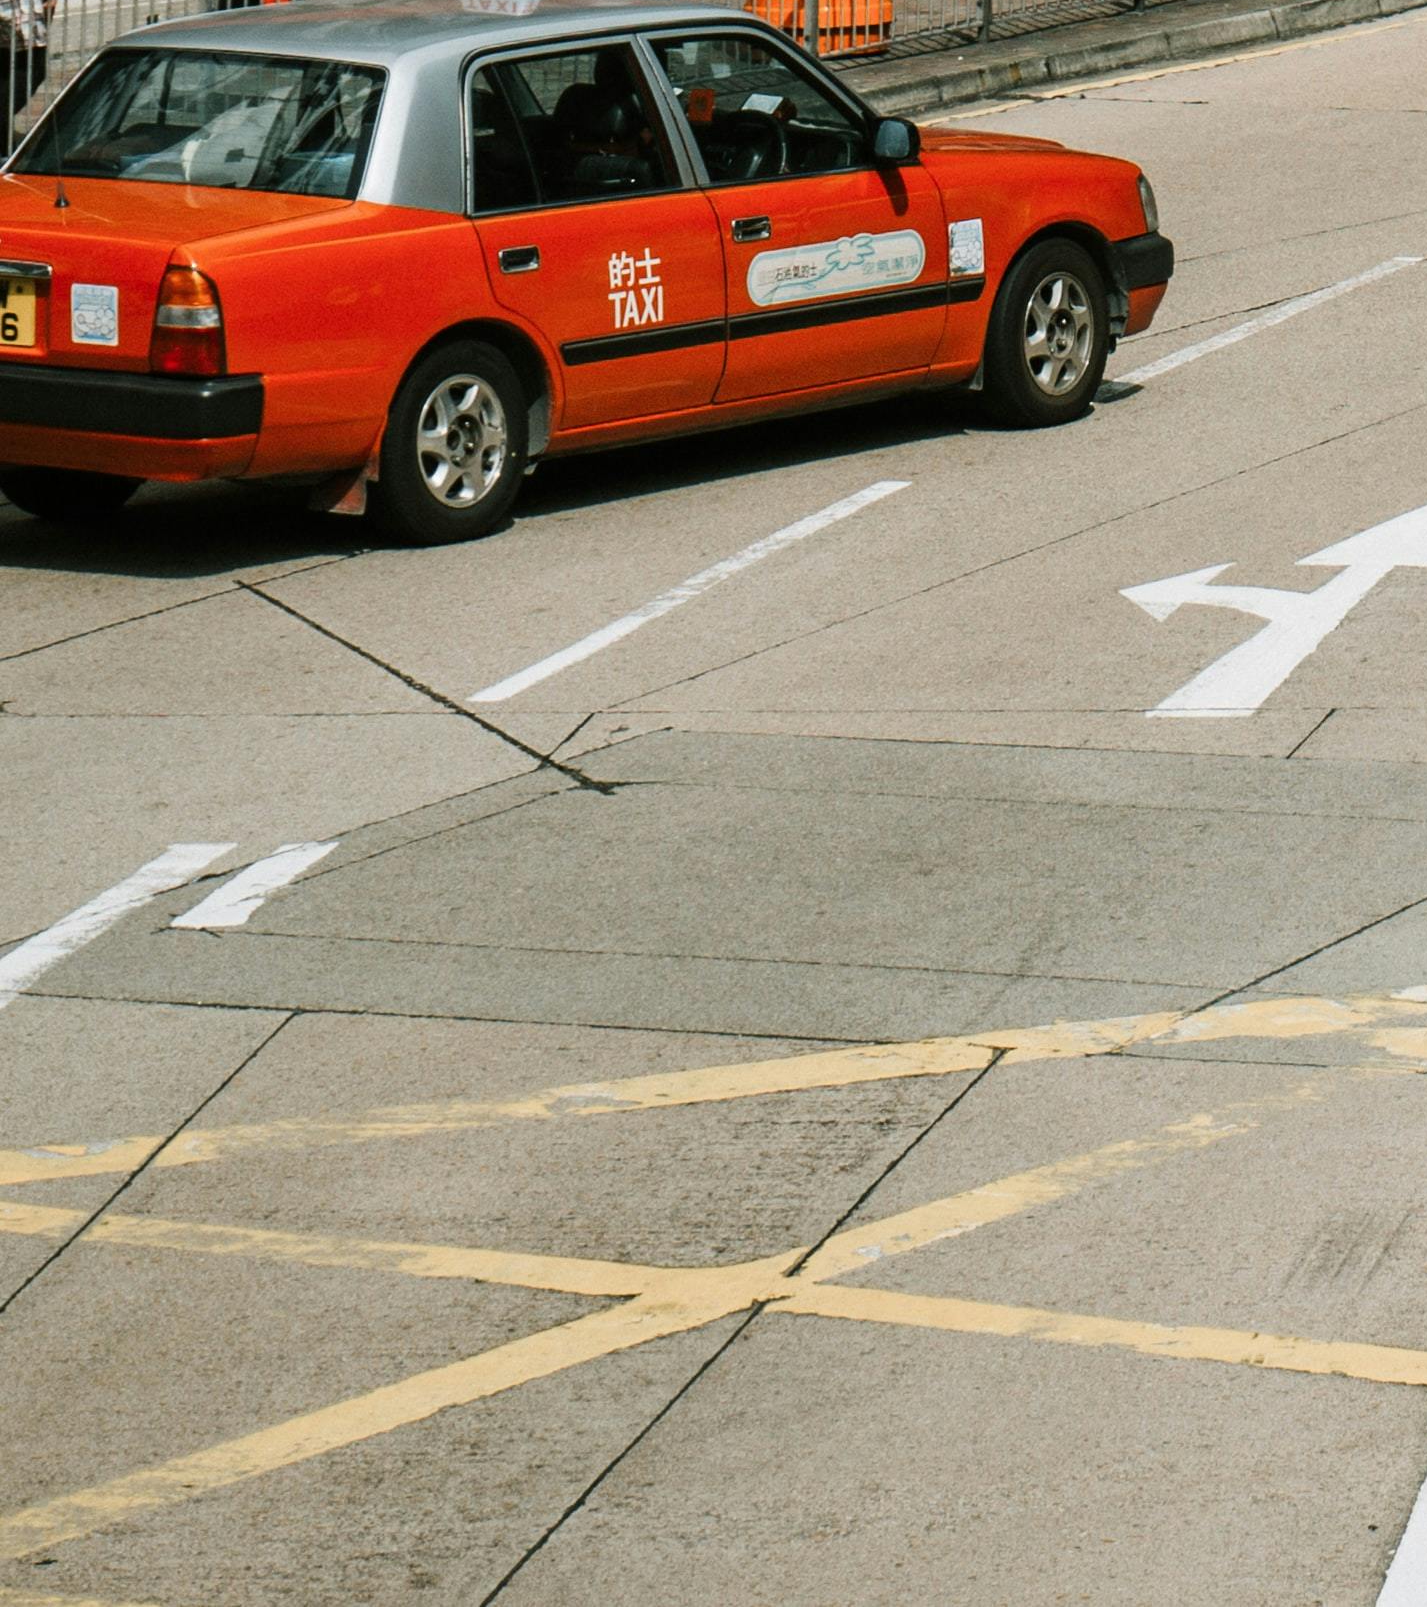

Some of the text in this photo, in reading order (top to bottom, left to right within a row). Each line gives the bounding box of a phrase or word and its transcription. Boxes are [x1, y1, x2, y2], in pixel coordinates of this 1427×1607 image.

[607, 247, 662, 290] 的士
[1, 312, 19, 342] 6
[607, 284, 664, 329] TAXI
